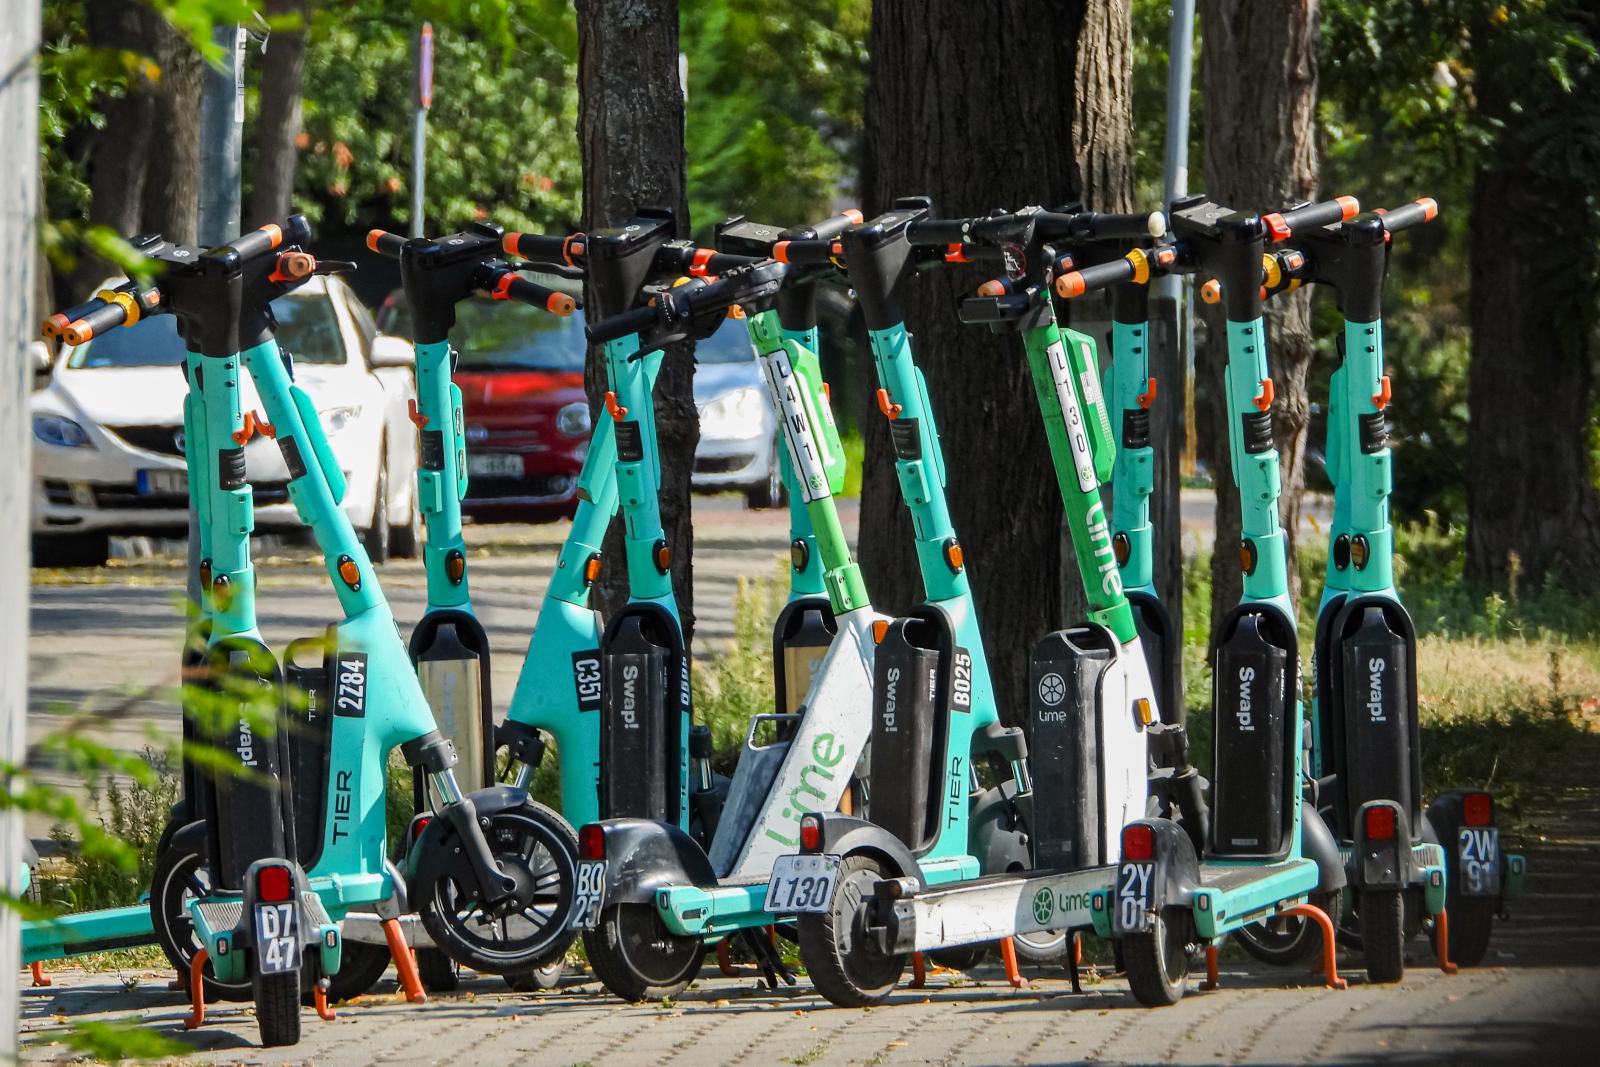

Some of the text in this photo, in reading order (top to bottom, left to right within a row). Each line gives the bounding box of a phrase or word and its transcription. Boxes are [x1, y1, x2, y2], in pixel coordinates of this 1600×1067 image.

[776, 360, 814, 461] L4W1
[1055, 352, 1086, 453] L130
[308, 688, 317, 722] TIER
[338, 659, 365, 711] 2Z84
[621, 665, 639, 729] Swap!
[883, 667, 900, 733] Swap!
[929, 668, 937, 702] TIER
[953, 653, 971, 707] B025
[1236, 666, 1255, 731] Swap!
[1367, 657, 1387, 722] Swap!
[1039, 710, 1067, 722] Lime
[332, 770, 352, 845] TIER
[948, 756, 963, 829] TIER
[1460, 829, 1498, 861] 2W
[769, 876, 830, 908] L130
[1121, 863, 1152, 897] 2Y
[261, 904, 293, 940] D7
[266, 937, 295, 971] 47
